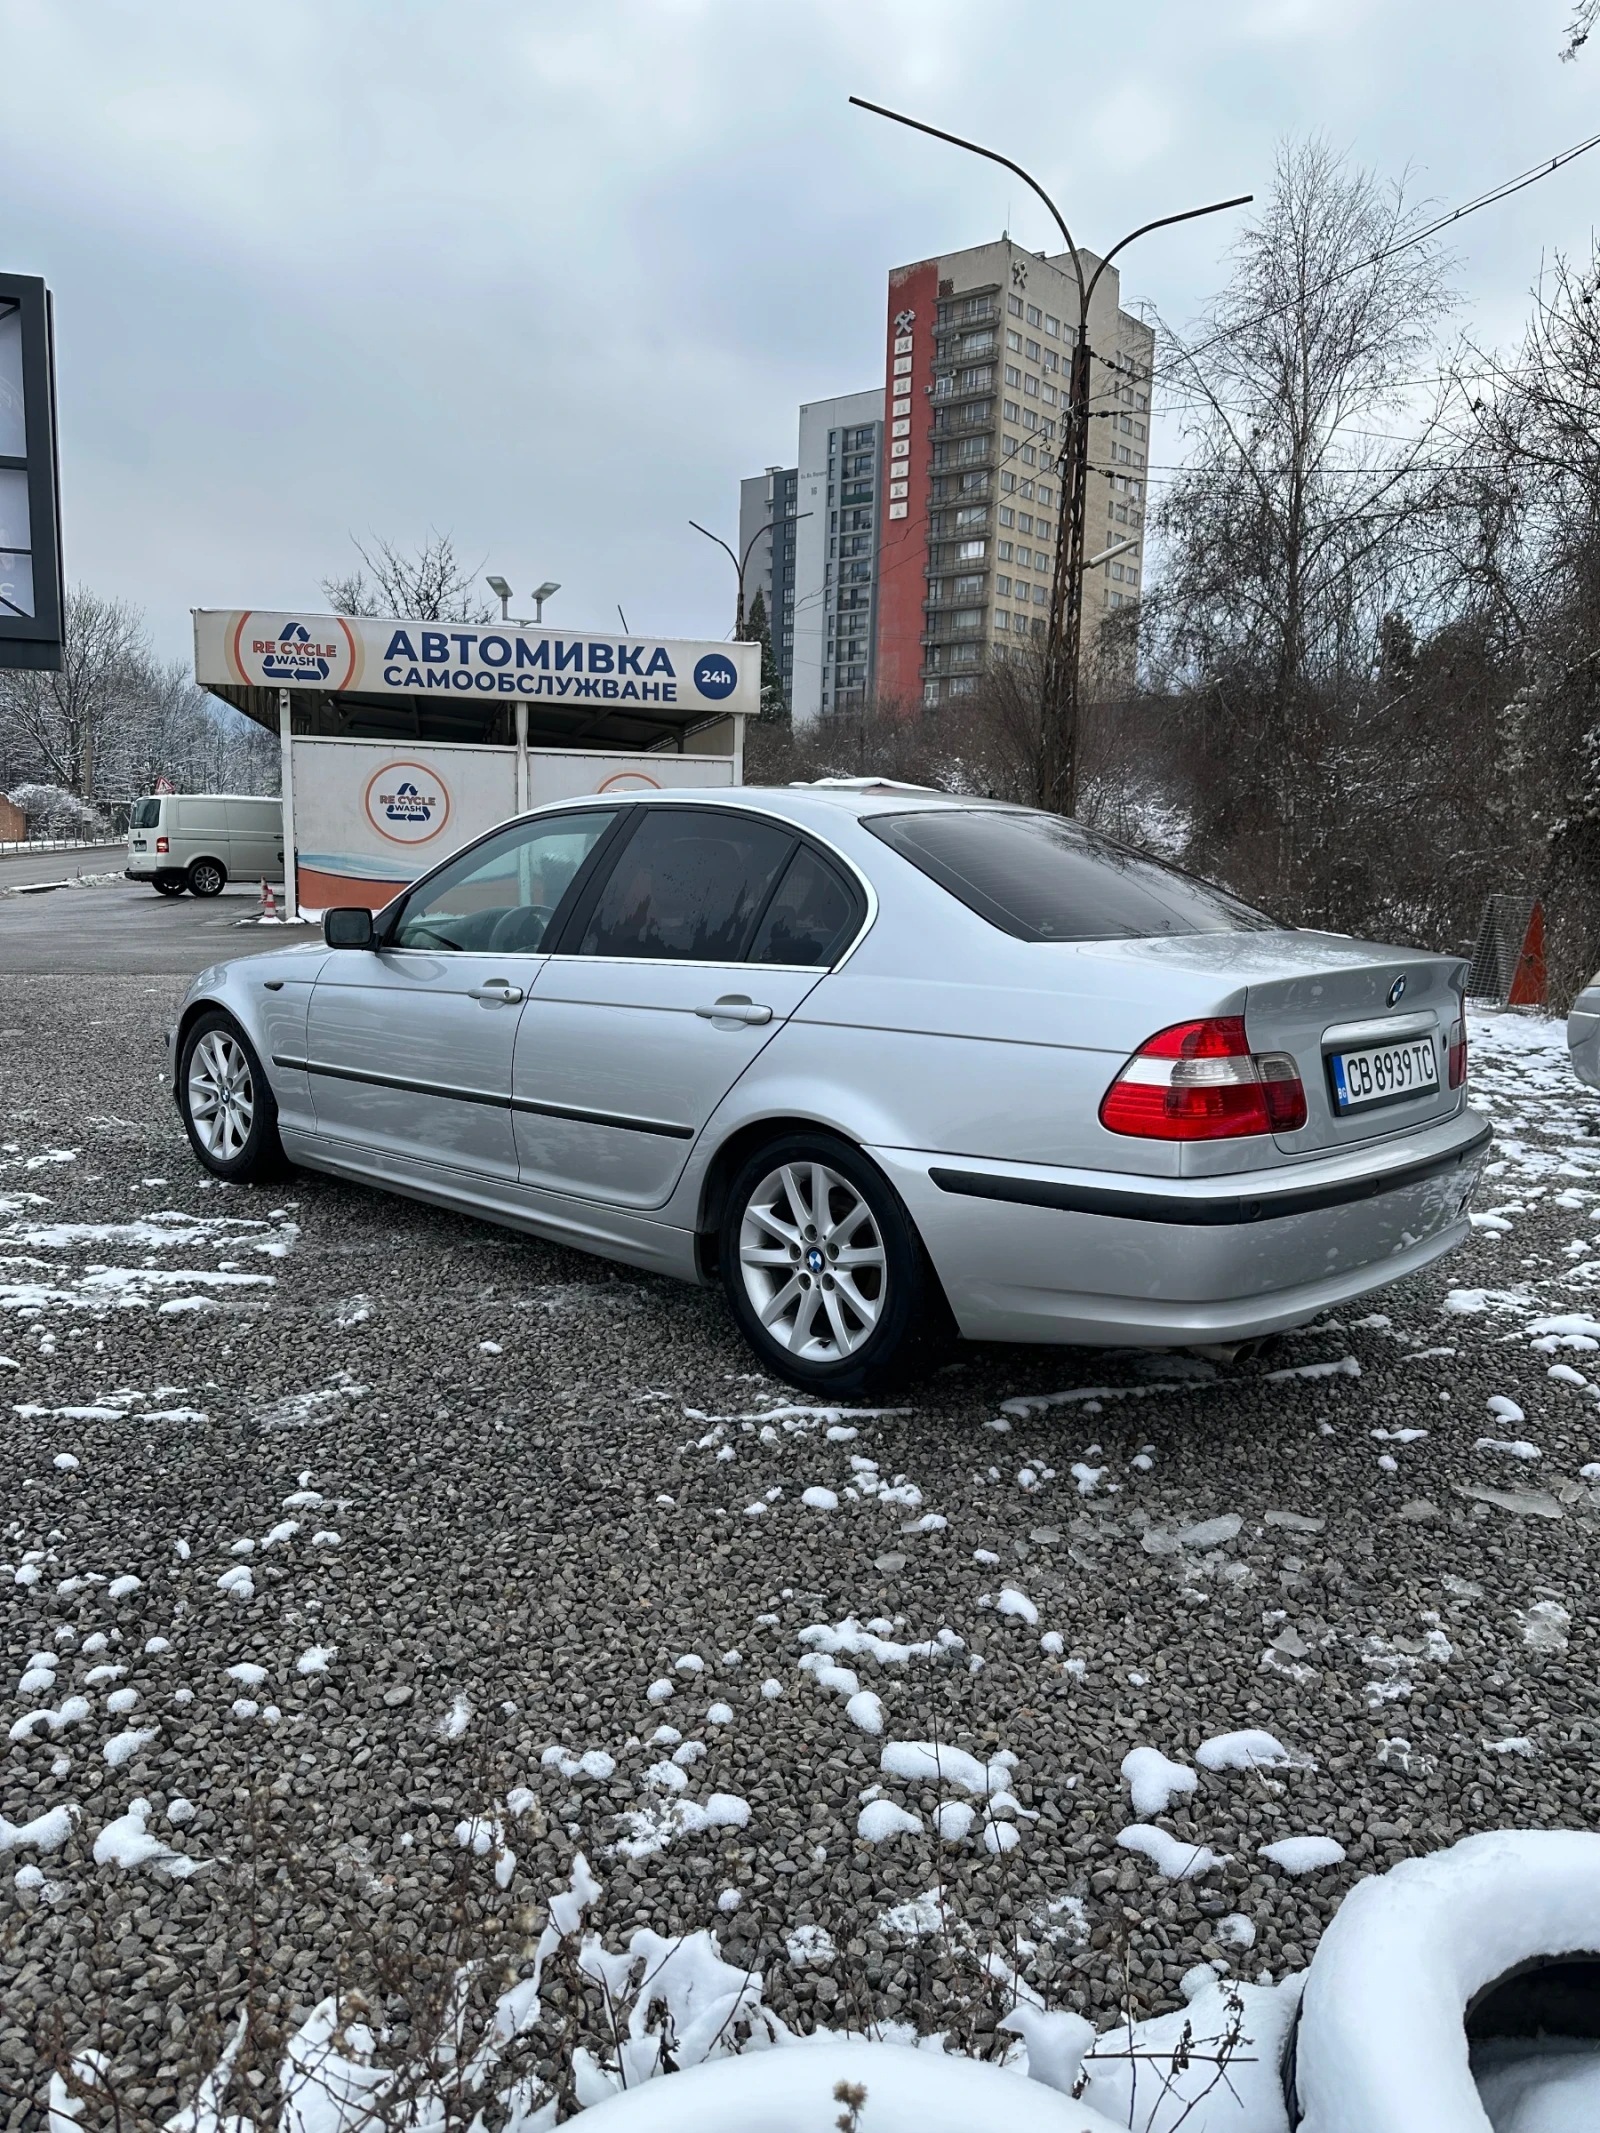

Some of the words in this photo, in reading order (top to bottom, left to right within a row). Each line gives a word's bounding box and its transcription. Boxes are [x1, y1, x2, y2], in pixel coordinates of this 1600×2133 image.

[252, 640, 276, 654] RE
[280, 641, 337, 658] CYCLE
[383, 629, 677, 678] АВТОМИВКА
[275, 655, 316, 667] WASH
[383, 665, 678, 702] САМООБСЛУЖВАНЕ
[701, 670, 731, 684] 24h
[379, 795, 396, 804] RE
[397, 796, 436, 806] CYCLE
[394, 804, 422, 813] WASH
[1338, 1087, 1347, 1099] BG
